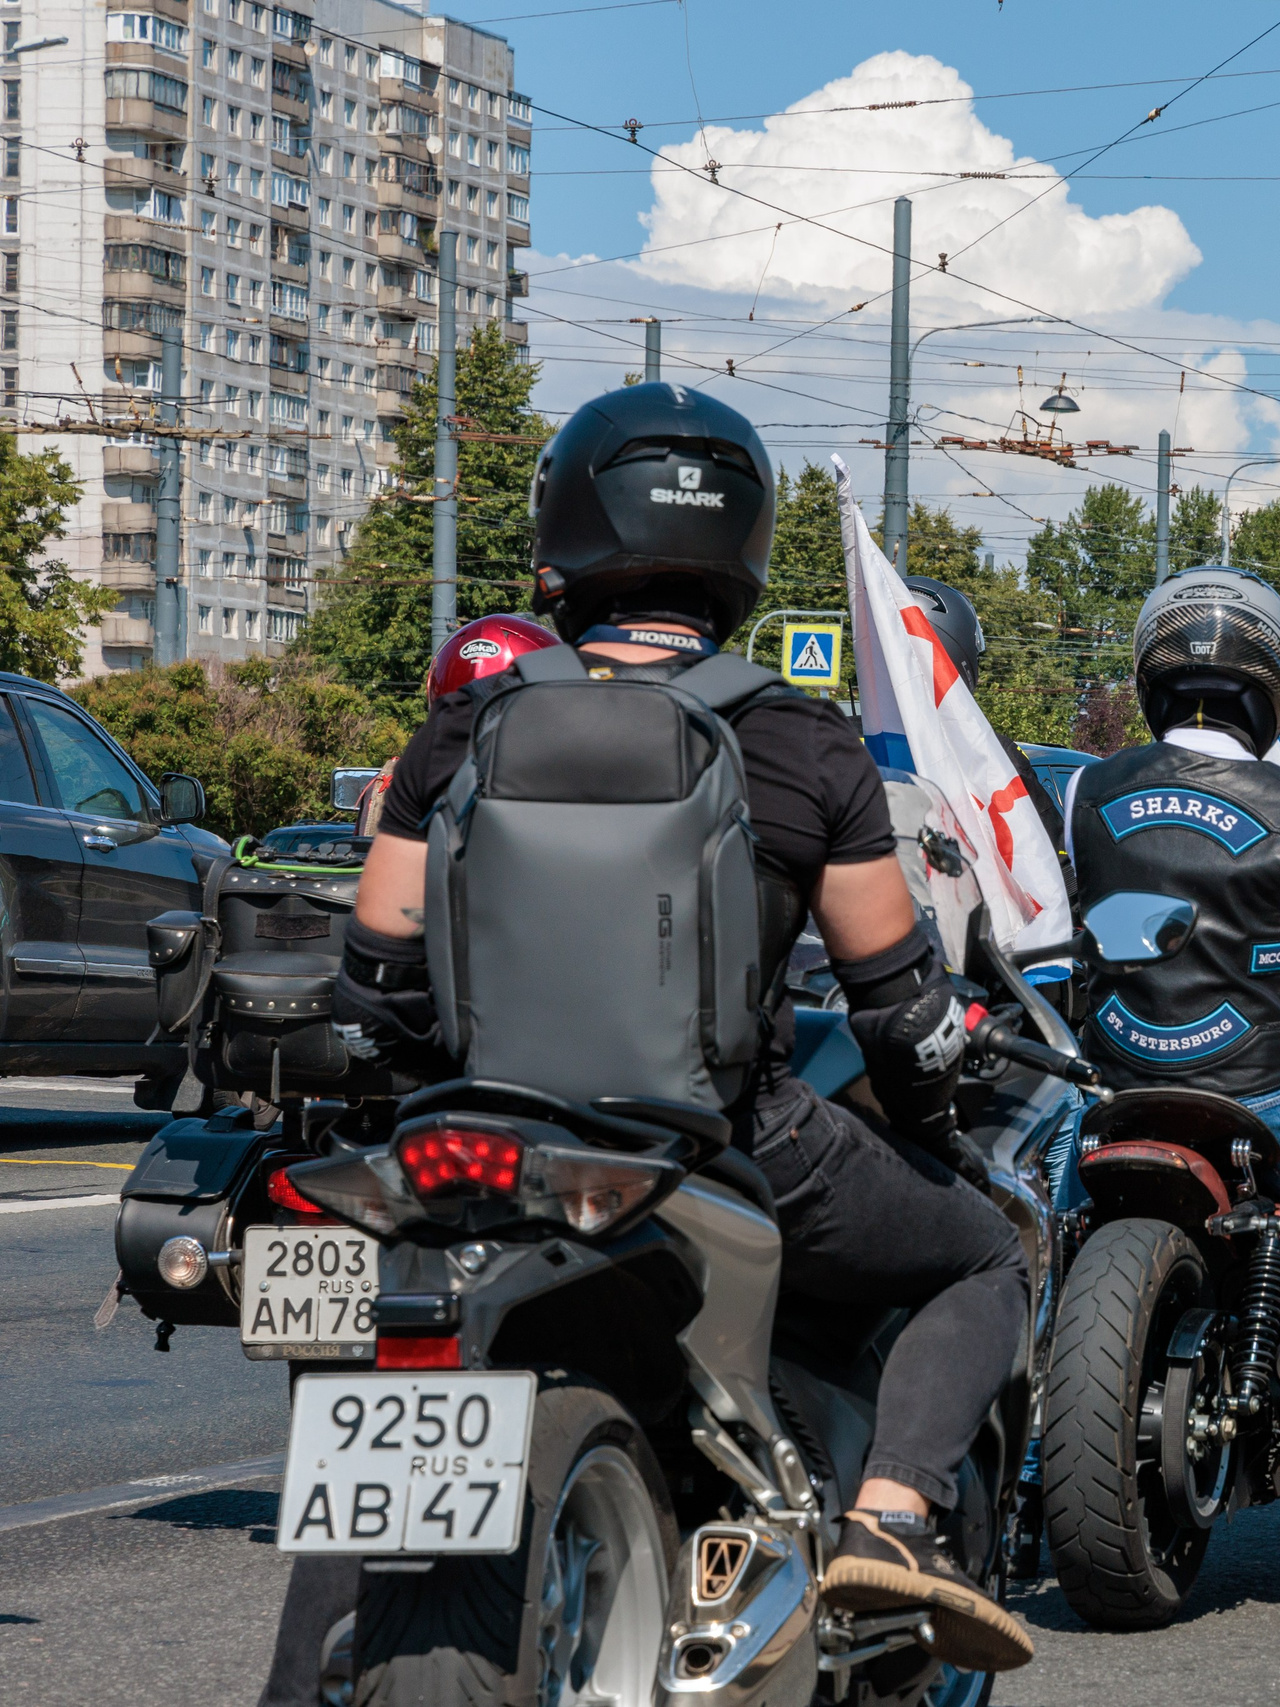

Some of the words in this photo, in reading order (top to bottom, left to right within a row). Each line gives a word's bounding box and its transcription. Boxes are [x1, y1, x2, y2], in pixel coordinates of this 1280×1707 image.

[650, 488, 724, 508] SHARK
[629, 630, 702, 651] HONDA
[1195, 646, 1211, 654] DOT
[1129, 797, 1238, 832] SHARKS
[1107, 1012, 1124, 1035] ST.
[1130, 1018, 1233, 1051] PETERSBURG
[266, 1240, 366, 1277] 2803
[318, 1280, 354, 1294] RUS
[250, 1297, 313, 1335] AM
[328, 1297, 377, 1334] 78
[282, 1344, 341, 1357] РОССИЯ
[331, 1394, 491, 1451] 9250
[410, 1455, 469, 1476] RUS
[293, 1483, 392, 1540] AB
[422, 1482, 503, 1539] 47
